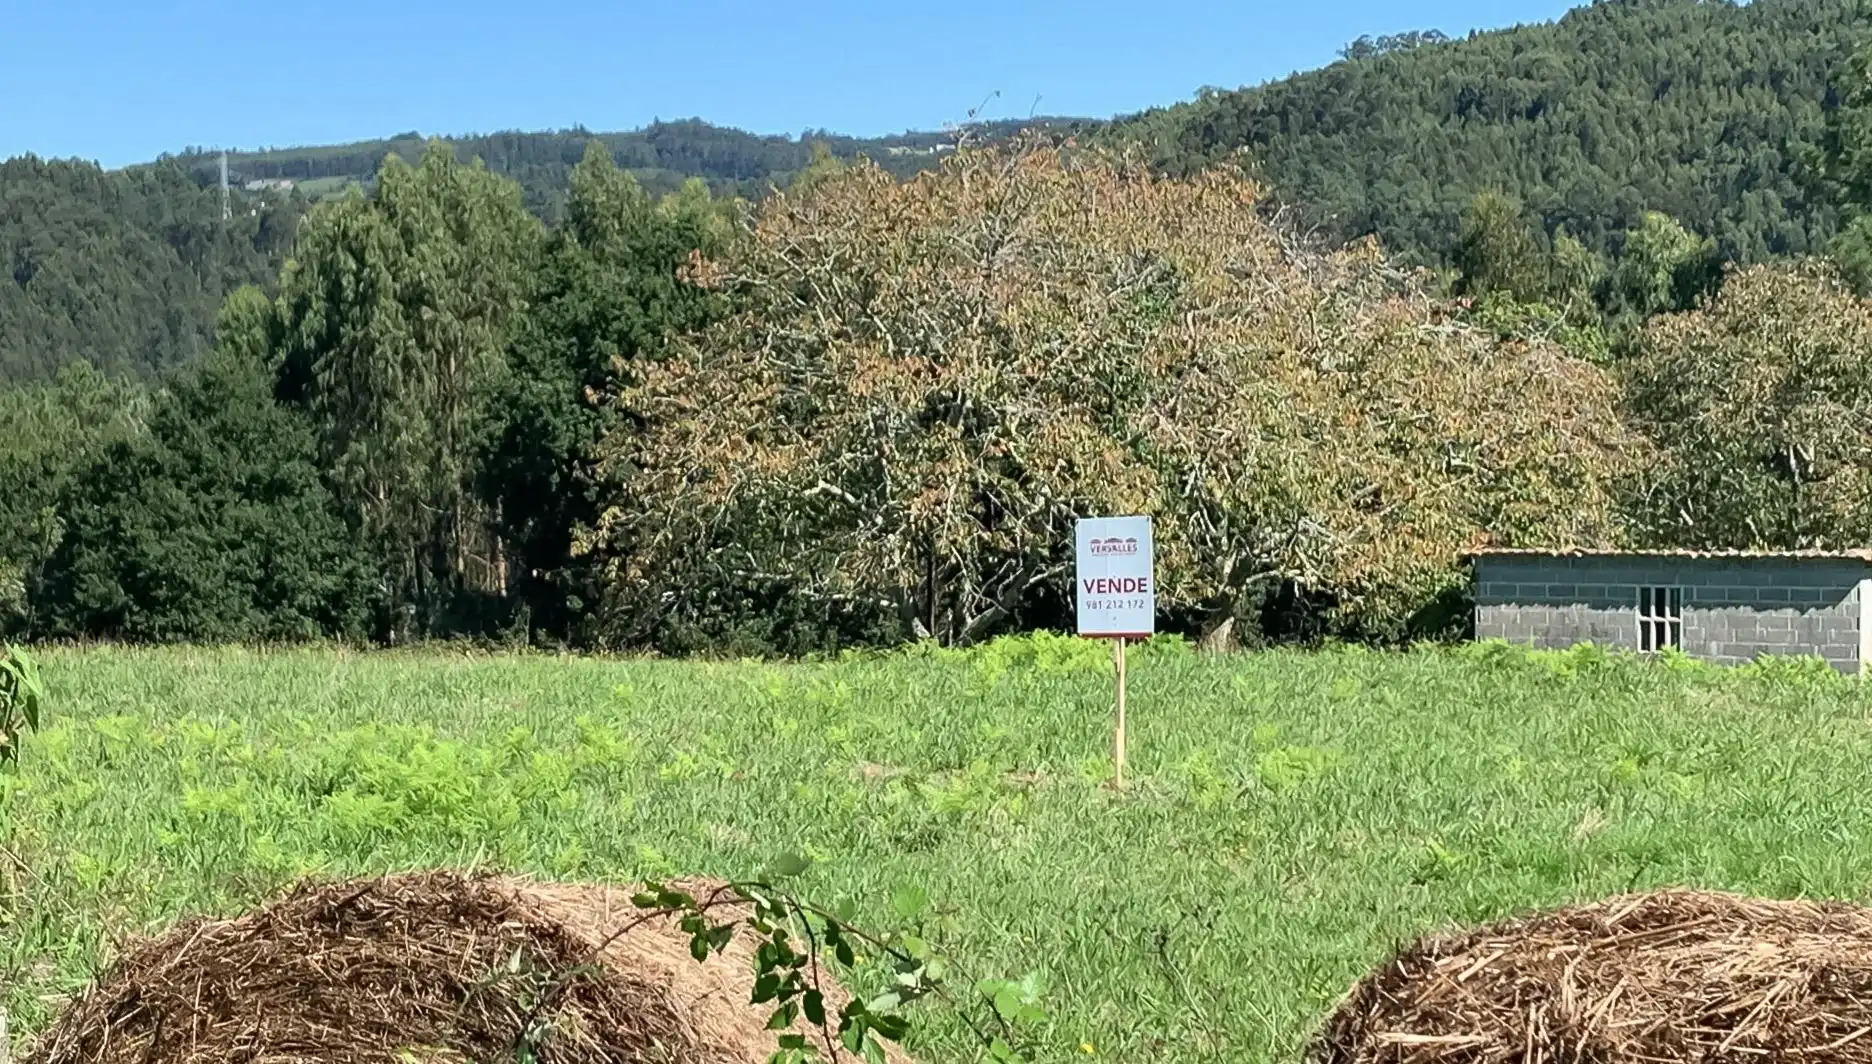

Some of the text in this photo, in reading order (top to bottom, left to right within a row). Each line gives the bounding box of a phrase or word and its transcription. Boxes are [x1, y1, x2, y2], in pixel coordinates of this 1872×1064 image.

[1091, 544, 1137, 553] VERSALLES
[1083, 578, 1147, 594] VENDE
[1086, 599, 1144, 610] 981 212 172
